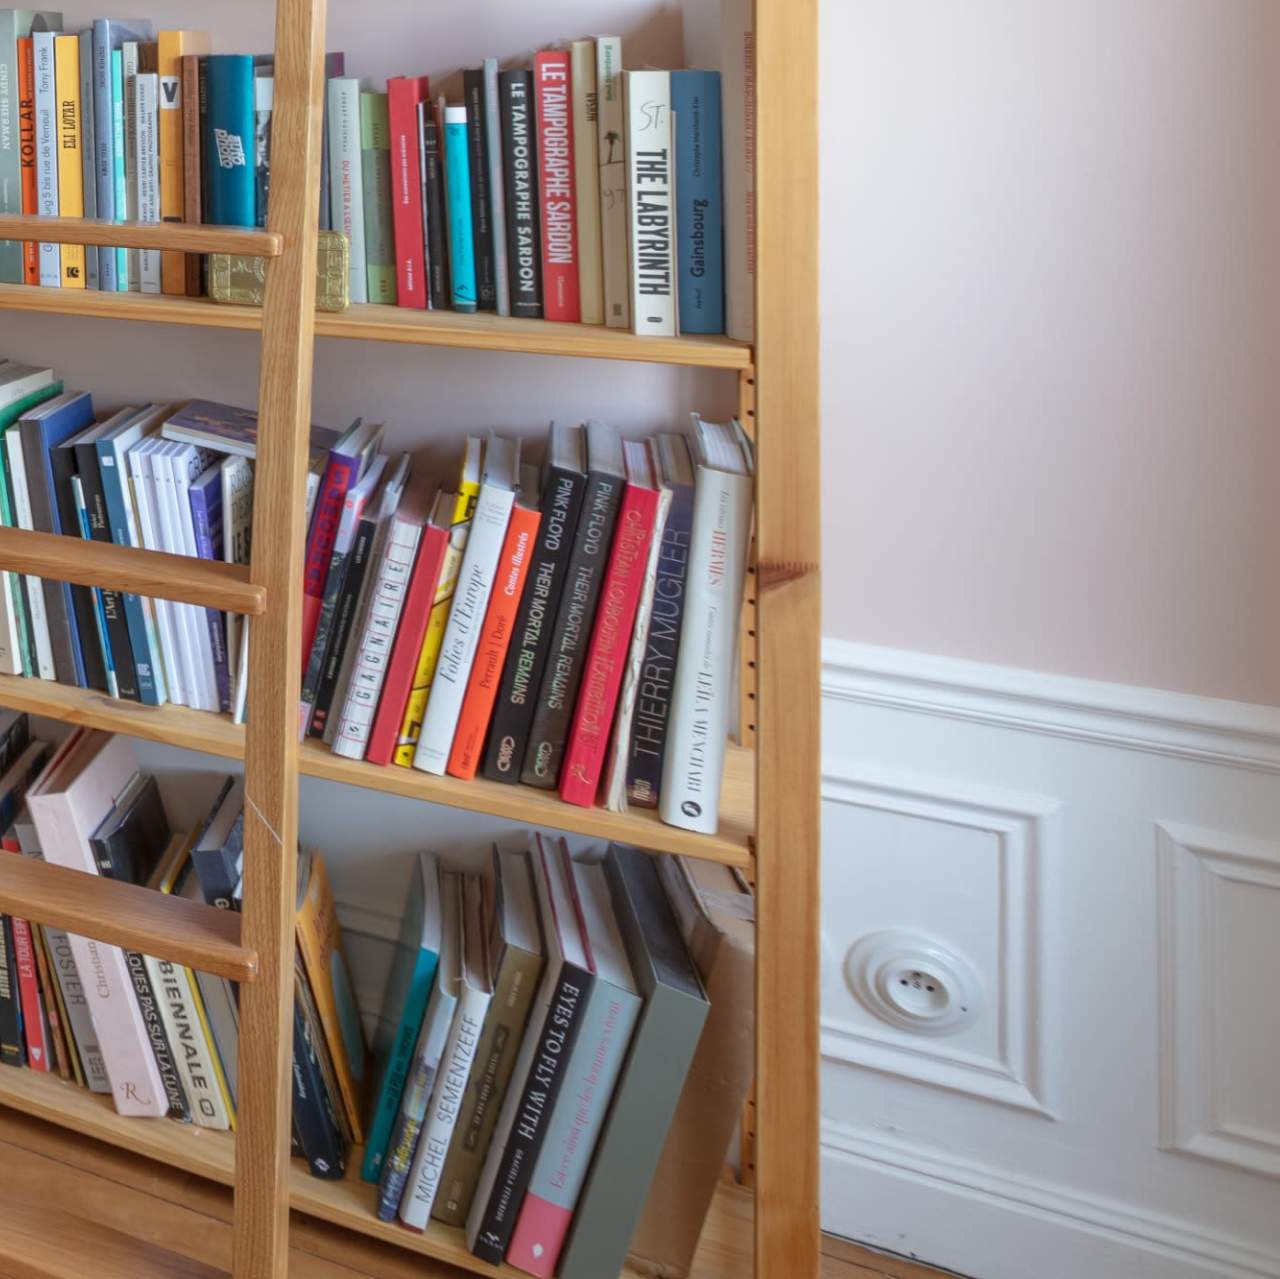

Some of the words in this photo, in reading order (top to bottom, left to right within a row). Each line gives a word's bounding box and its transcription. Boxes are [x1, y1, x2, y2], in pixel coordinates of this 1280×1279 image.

[38, 47, 50, 72] Frank
[543, 64, 565, 81] LE
[38, 75, 51, 94] Tony
[162, 82, 178, 103] V
[510, 83, 524, 97] LE
[19, 99, 35, 168] KOLLAR
[38, 109, 51, 144] Verneuil
[61, 100, 75, 130] LOTAR
[40, 146, 51, 158] de
[61, 135, 74, 148] ELI
[543, 84, 569, 197] TAMPOGRAPHE
[42, 160, 51, 175] rue
[509, 103, 533, 220] TAMPOGRAPHE
[637, 150, 667, 184] THE
[41, 177, 52, 191] bis
[546, 201, 572, 263] SARDON
[638, 190, 669, 296] LABYRINTH
[689, 199, 708, 278] Gainsbourg
[516, 227, 535, 291] SARDON
[552, 478, 571, 511] PINK
[591, 480, 611, 515] PINK
[545, 511, 563, 552] FLOYD
[582, 513, 604, 556] FLOYD
[448, 561, 491, 636] d'Europe
[533, 561, 555, 599] THEIR
[571, 564, 592, 604] THEIR
[355, 562, 404, 702] GAGNAIRE
[521, 598, 546, 649] MORTAL
[557, 602, 584, 656] MORTAL
[630, 651, 670, 760] THIERRY
[650, 524, 690, 640] MUGLER
[438, 636, 468, 684] Folies
[477, 648, 499, 689] Perrault
[508, 647, 536, 707] REMAINS
[546, 653, 571, 711] REMAINS
[17, 936, 31, 961] TOUR
[22, 964, 33, 977] LA
[53, 933, 85, 1007] FOSTER
[87, 940, 112, 1000] Christian
[142, 995, 157, 1022] PAS
[553, 983, 580, 1027] EYES
[148, 1022, 166, 1051] SUR
[545, 1029, 565, 1053] TO
[534, 1056, 557, 1088] FLY
[413, 1134, 448, 1204] MICHEL
[434, 1015, 481, 1125] SEMENTZEFF
[517, 1089, 547, 1140] WITH
